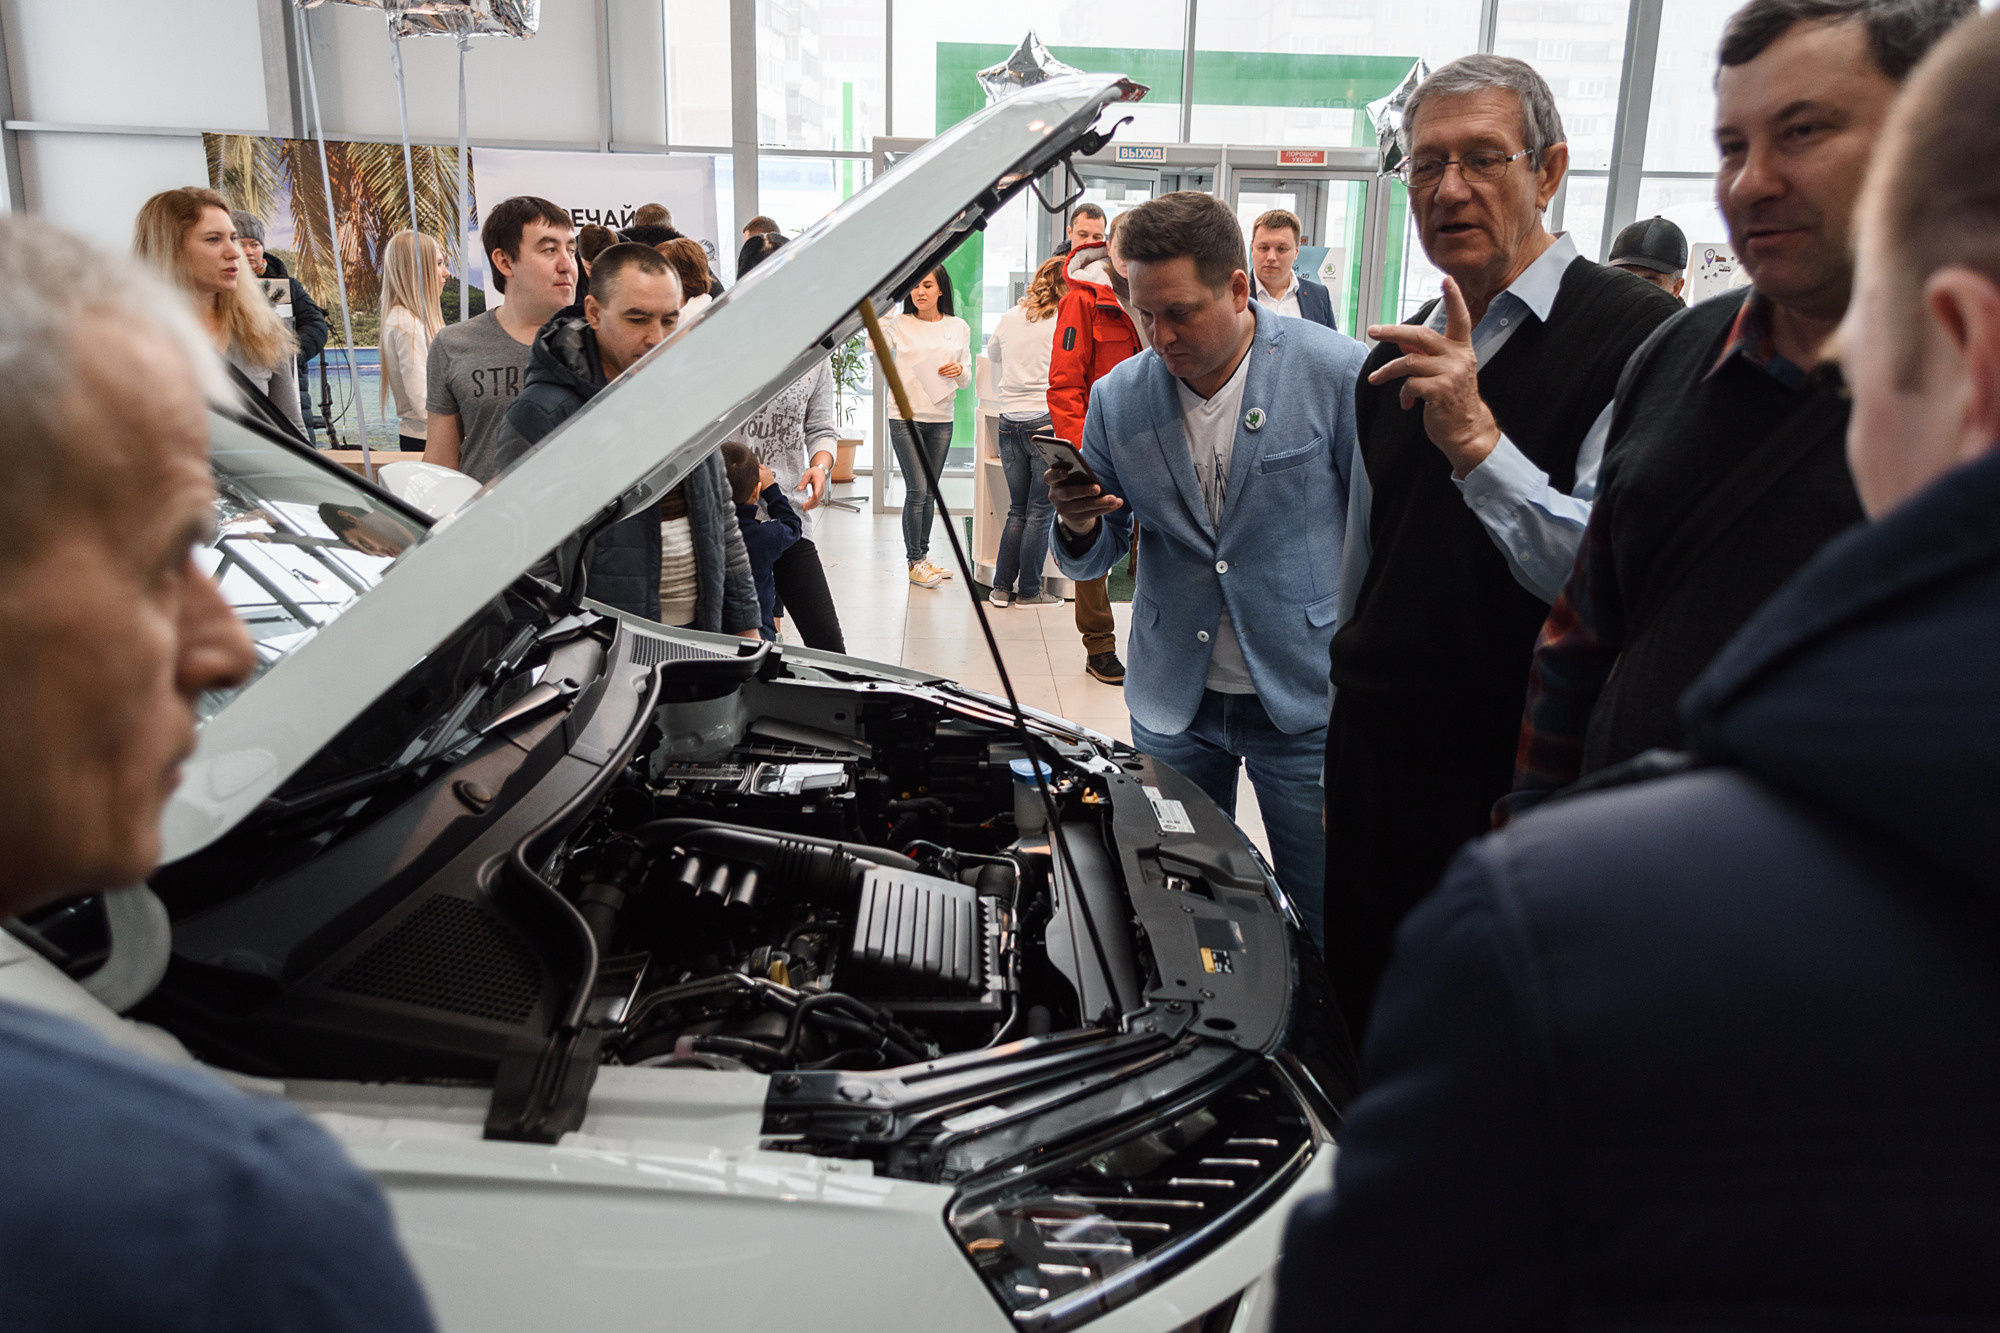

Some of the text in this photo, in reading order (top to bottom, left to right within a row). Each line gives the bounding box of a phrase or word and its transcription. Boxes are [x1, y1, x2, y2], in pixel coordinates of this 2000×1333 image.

[1121, 148, 1161, 159] ВЫХОД
[562, 205, 636, 228] ЕЧАЙ
[471, 366, 519, 398] STR
